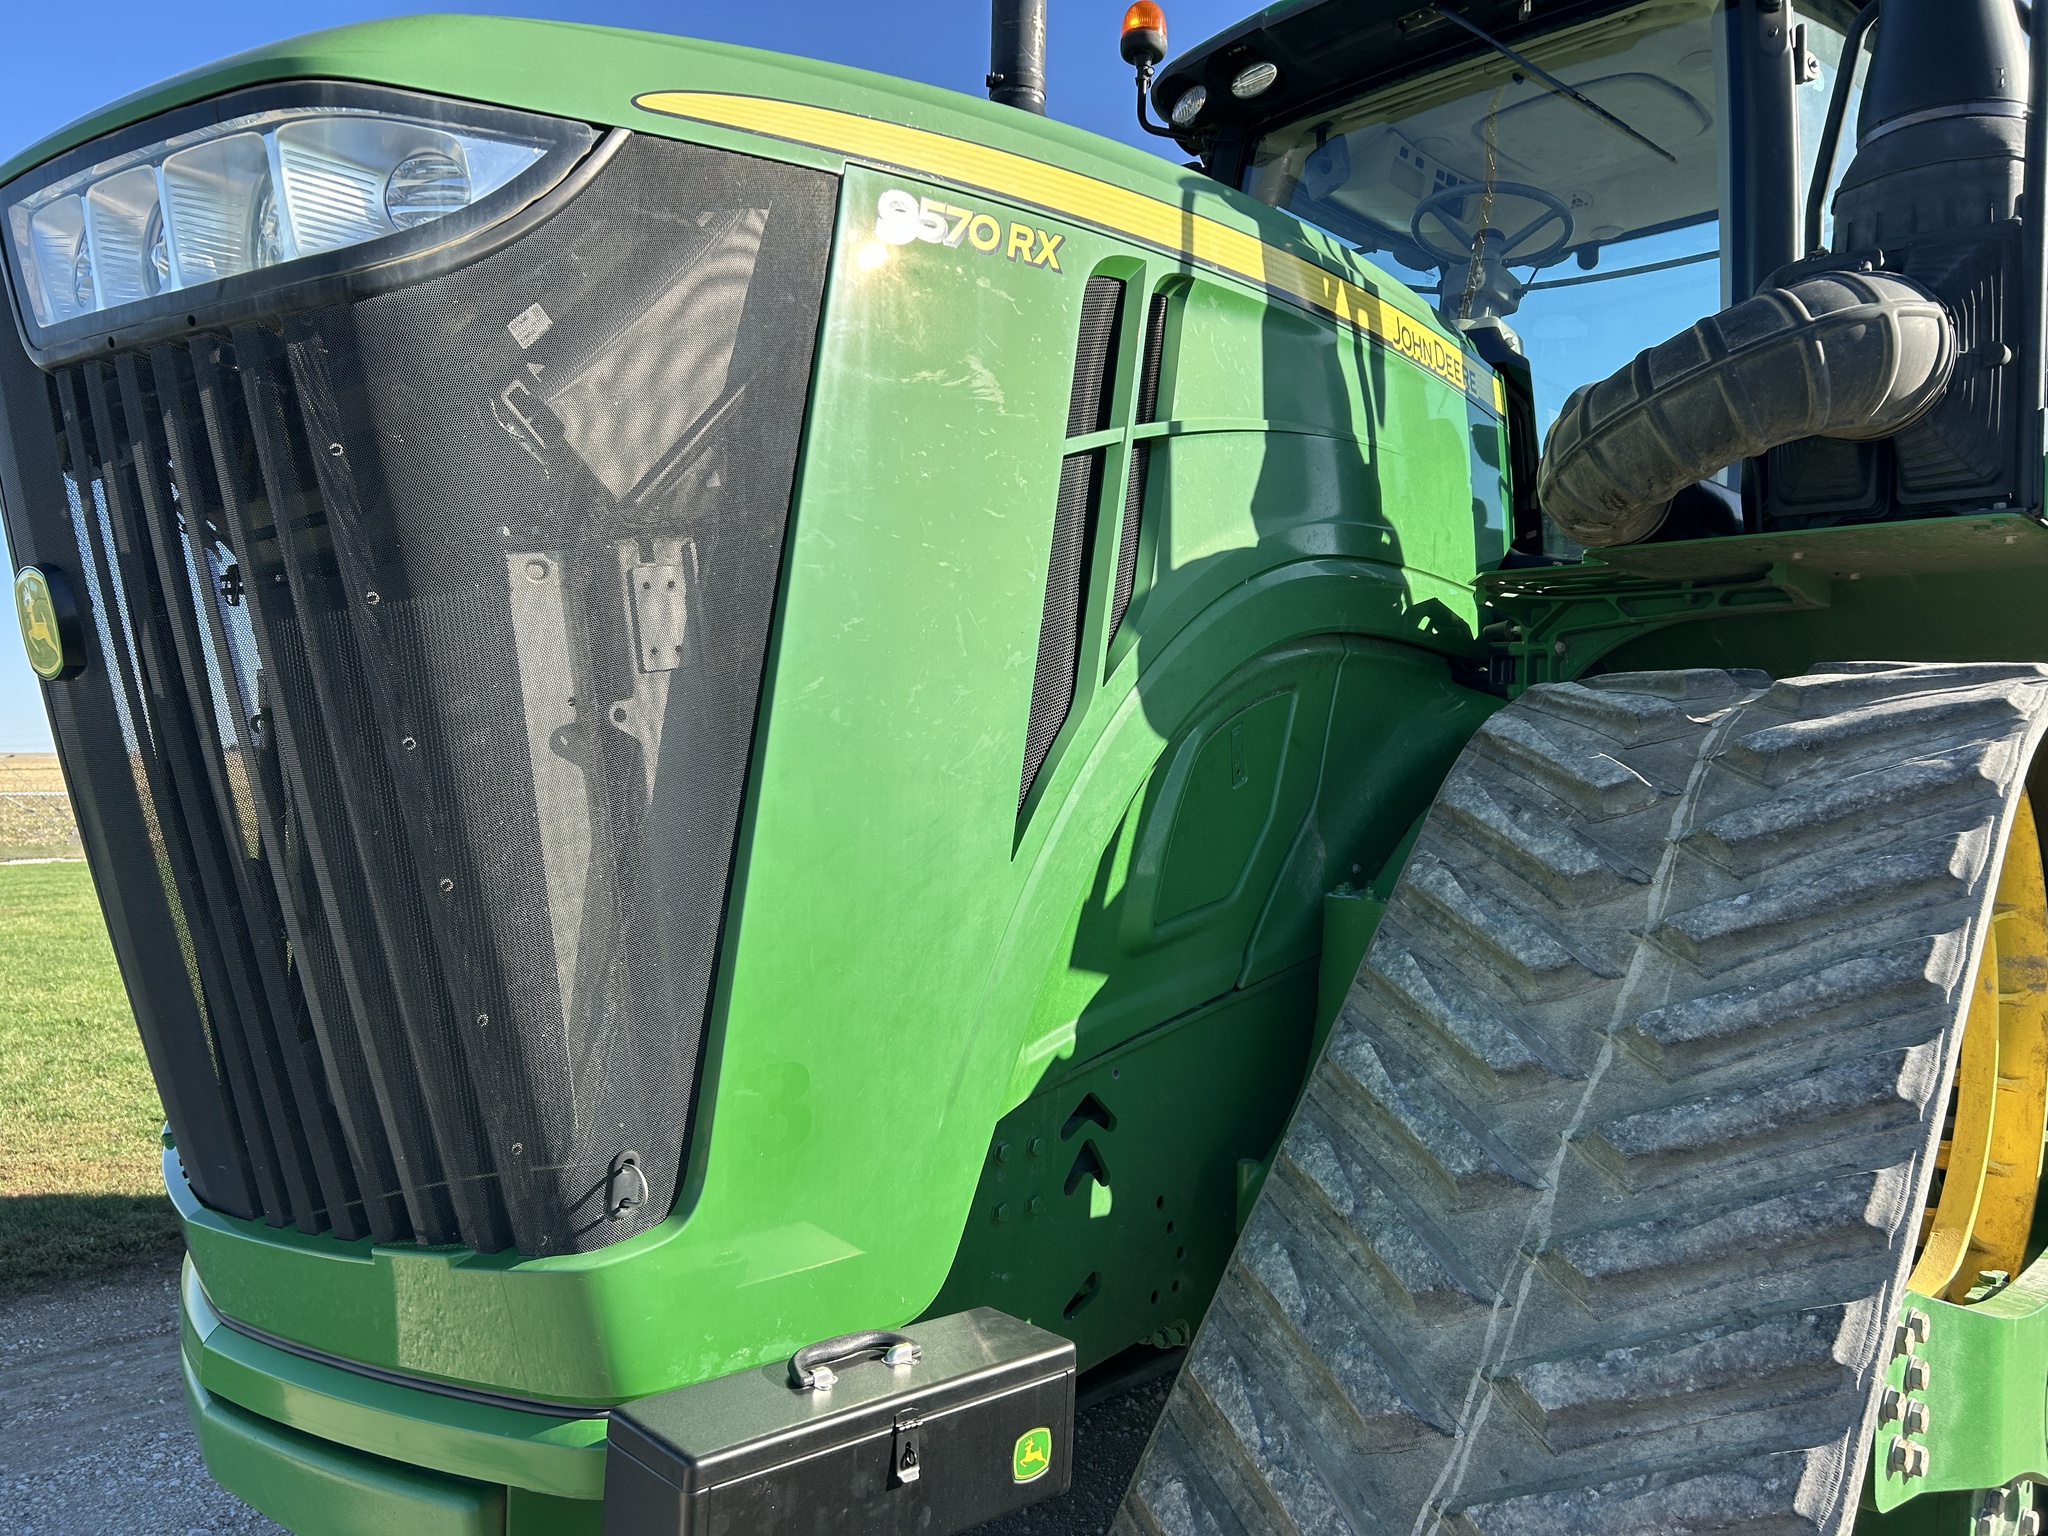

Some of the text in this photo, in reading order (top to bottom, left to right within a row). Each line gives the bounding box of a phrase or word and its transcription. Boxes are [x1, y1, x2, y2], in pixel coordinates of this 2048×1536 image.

[876, 189, 1066, 274] 9570 RX
[1392, 315, 1478, 397] JOHN DEERE
